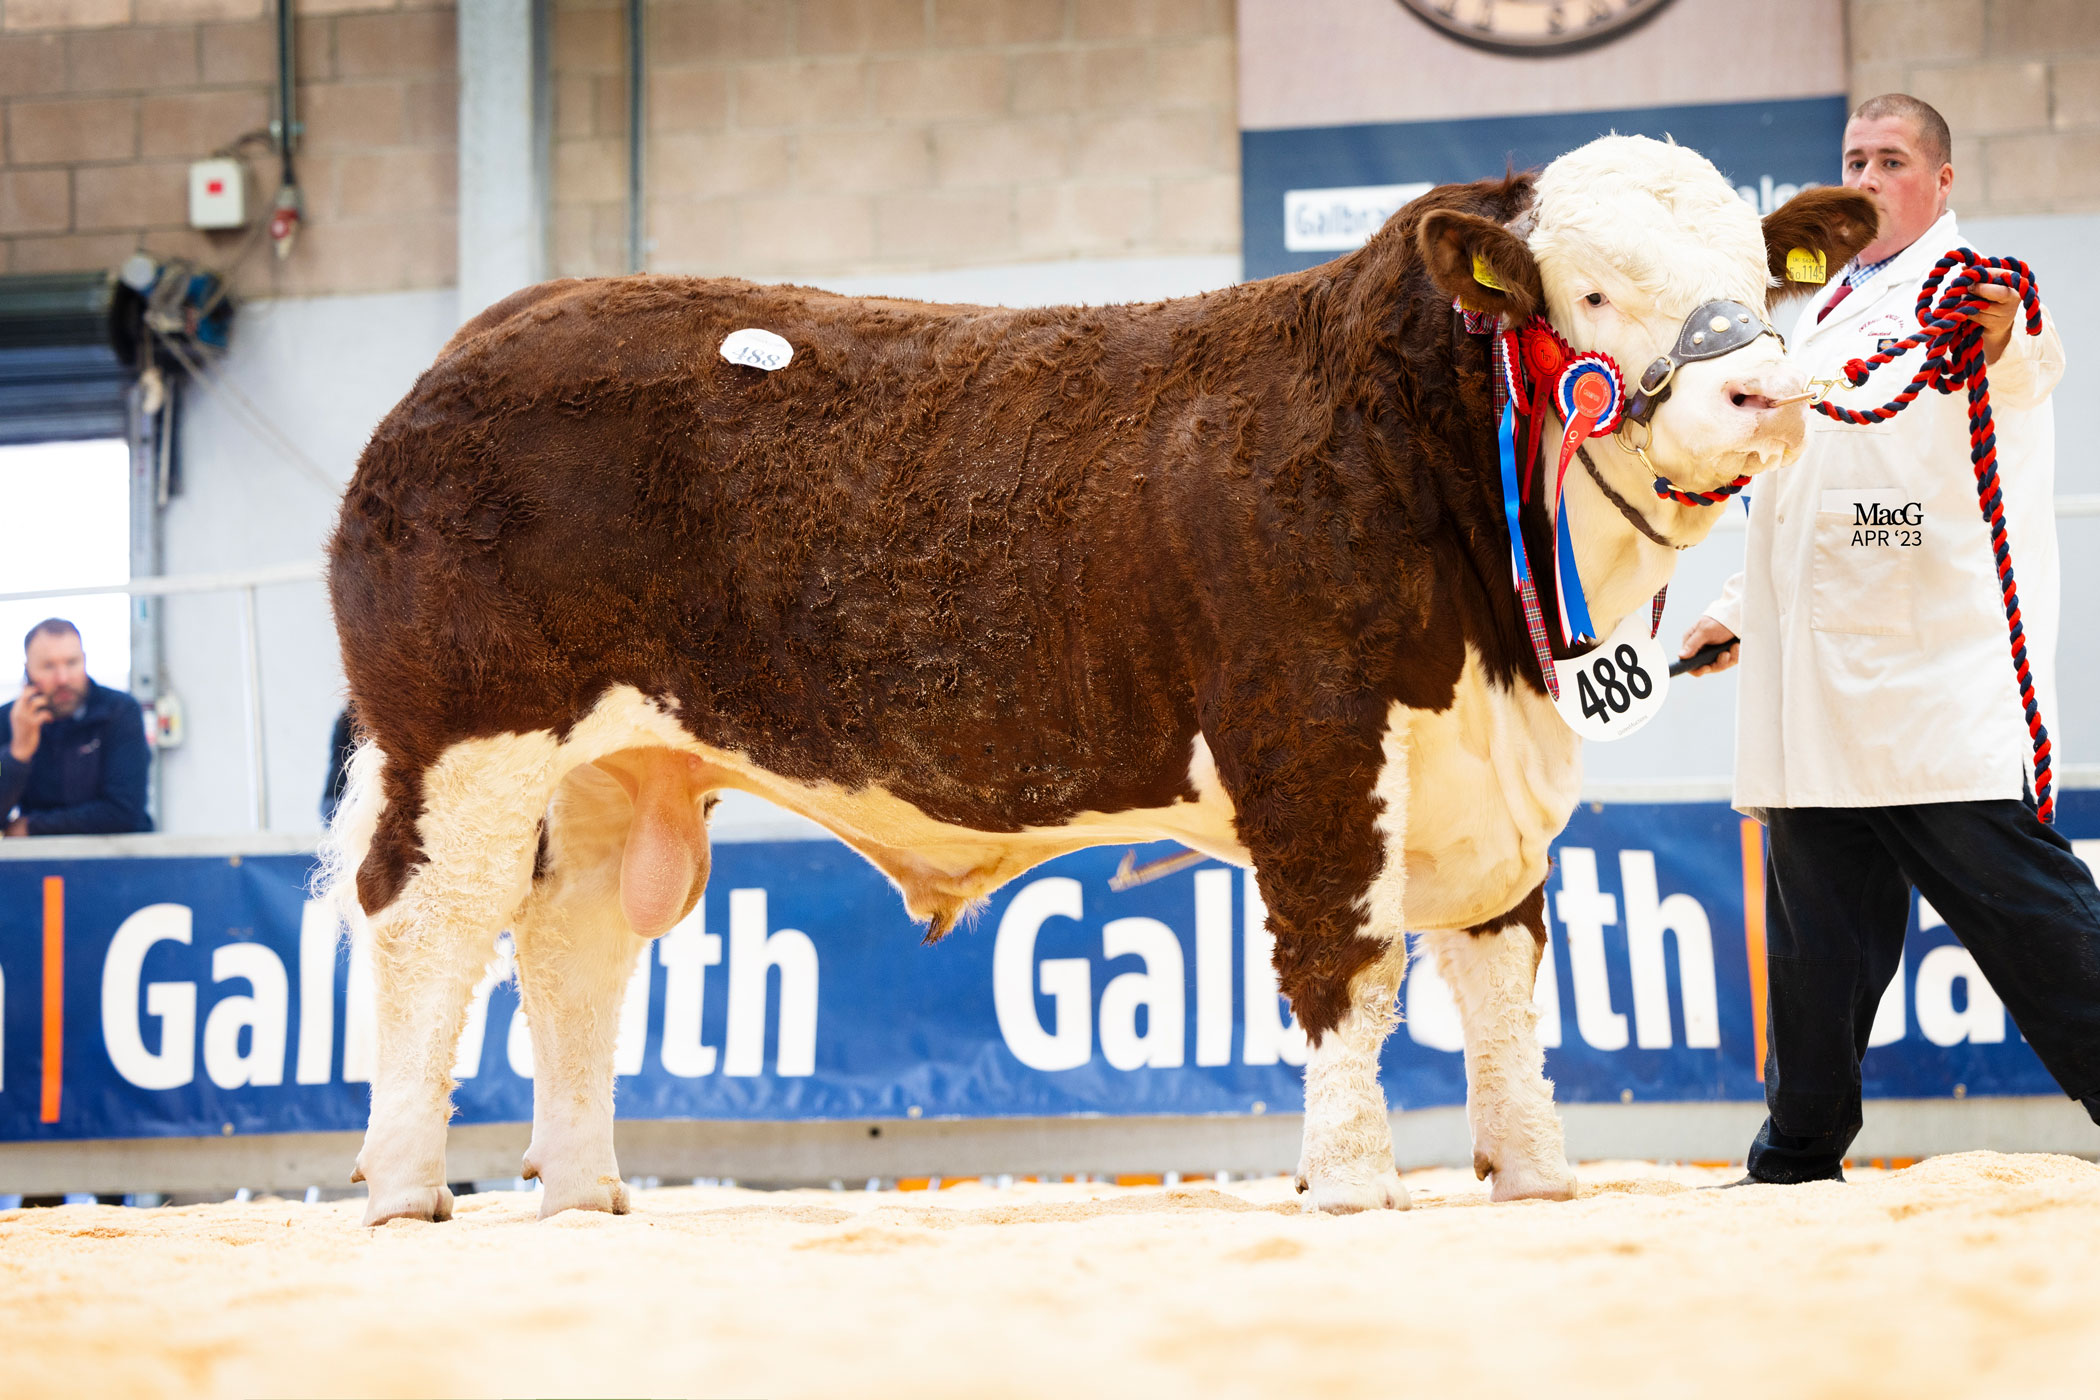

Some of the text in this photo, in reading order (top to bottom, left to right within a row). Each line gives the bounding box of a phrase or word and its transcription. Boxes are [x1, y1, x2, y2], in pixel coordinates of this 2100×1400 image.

[1295, 201, 1400, 235] Galbra
[732, 346, 781, 368] 488
[1576, 643, 1653, 724] 488
[993, 847, 1721, 1072] Galbth
